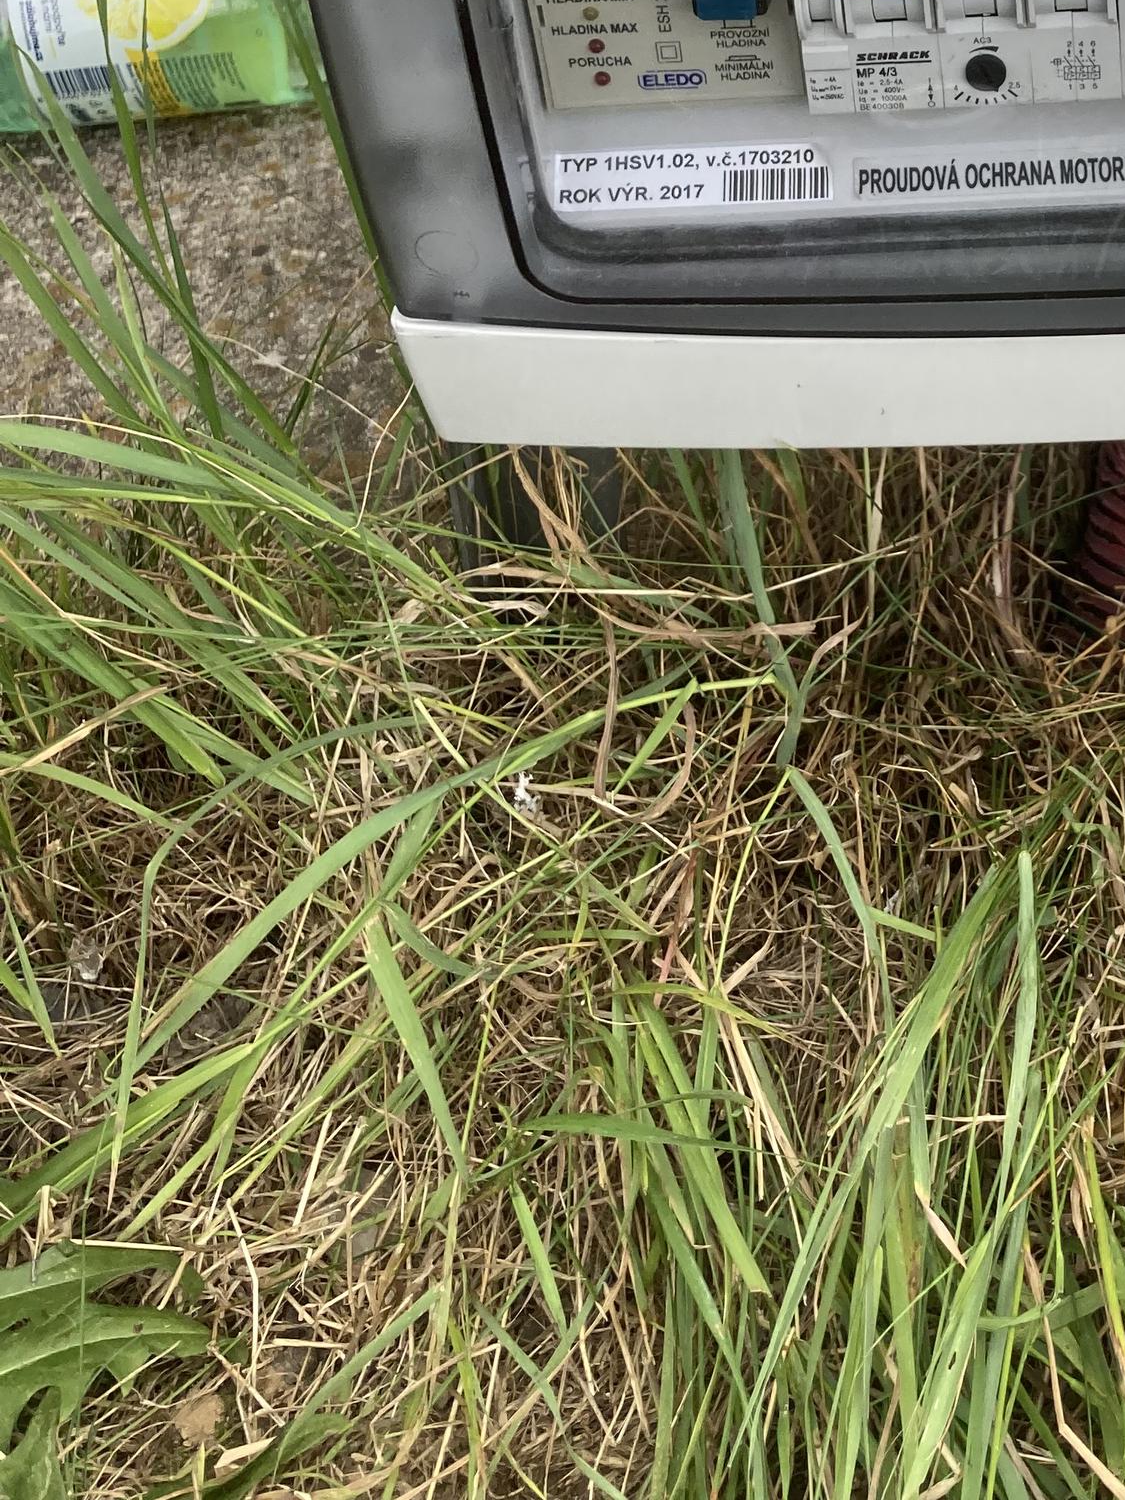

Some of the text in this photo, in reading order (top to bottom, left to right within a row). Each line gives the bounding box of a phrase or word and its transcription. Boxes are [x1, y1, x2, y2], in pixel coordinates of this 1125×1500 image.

[656, 5, 672, 32] ESH
[551, 23, 638, 36] HLADINA MAX
[710, 28, 770, 39] PROVOZNÍ
[716, 39, 767, 48] HLADINA
[856, 50, 930, 61] SCHRACK
[568, 56, 632, 68] PORUCHA
[715, 60, 774, 72] MINIMÁLNÍ
[720, 71, 770, 80] HLADINA
[856, 67, 898, 78] MP 4/3
[642, 73, 703, 87] ELEDO
[561, 149, 814, 172] TYP 1HSV1.02, v.č.1703210
[858, 159, 960, 195] PROUDOVÁ
[965, 160, 1056, 189] OCHRANA
[559, 182, 705, 204] ROK VÝR. 2017
